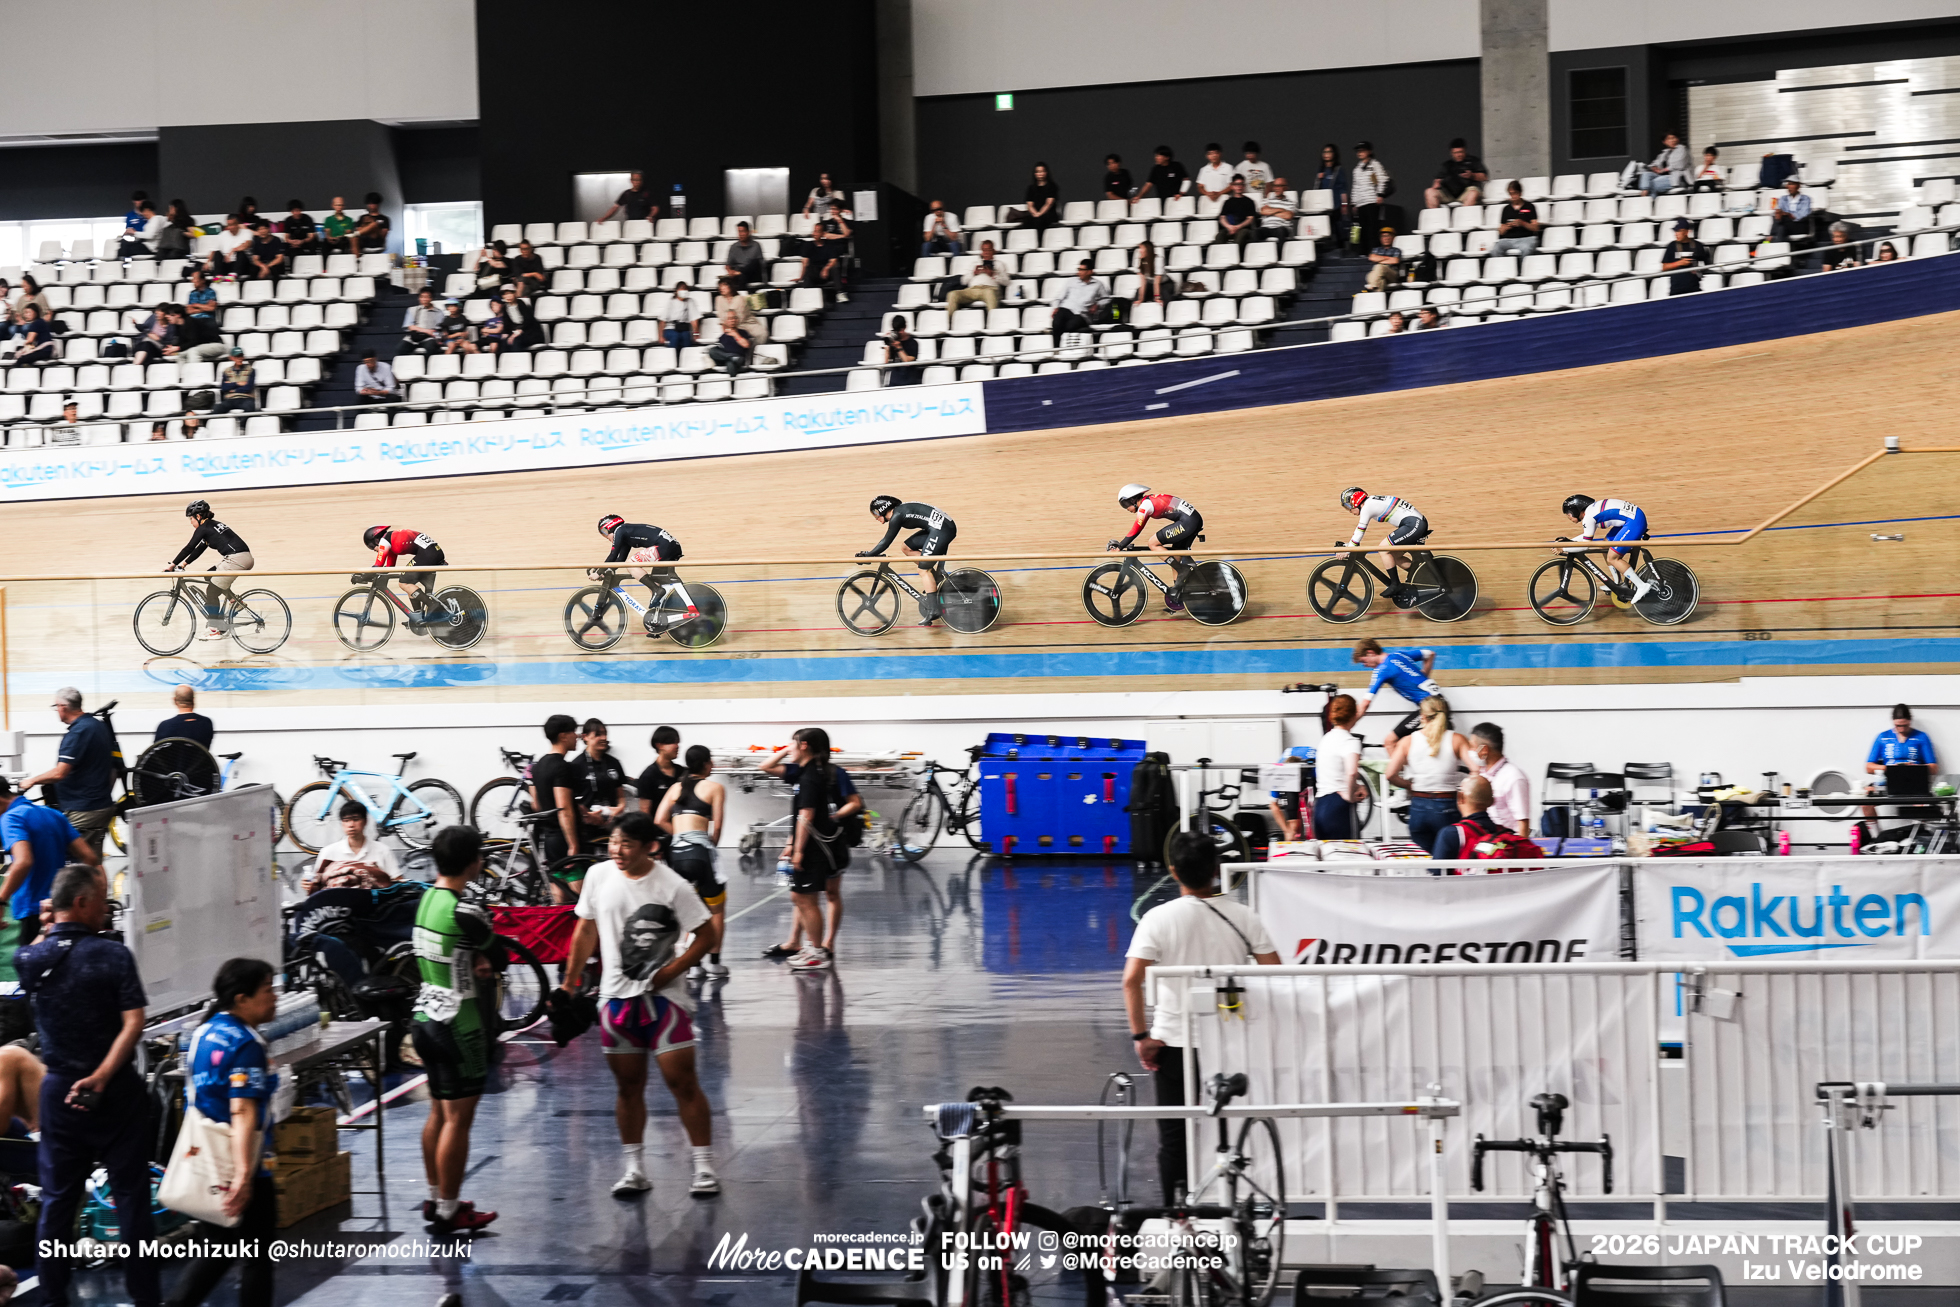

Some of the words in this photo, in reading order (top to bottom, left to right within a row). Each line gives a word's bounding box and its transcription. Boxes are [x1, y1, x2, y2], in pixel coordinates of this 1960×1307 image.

[783, 408, 870, 431] Rakuten
[580, 425, 665, 446] Rakuten
[380, 440, 464, 461] Rakuten
[0, 463, 69, 483] akuten
[181, 453, 265, 472] Rakuten
[1165, 524, 1186, 540] CHINA
[1139, 566, 1168, 594] KOGA
[1670, 882, 1931, 938] Rakuten
